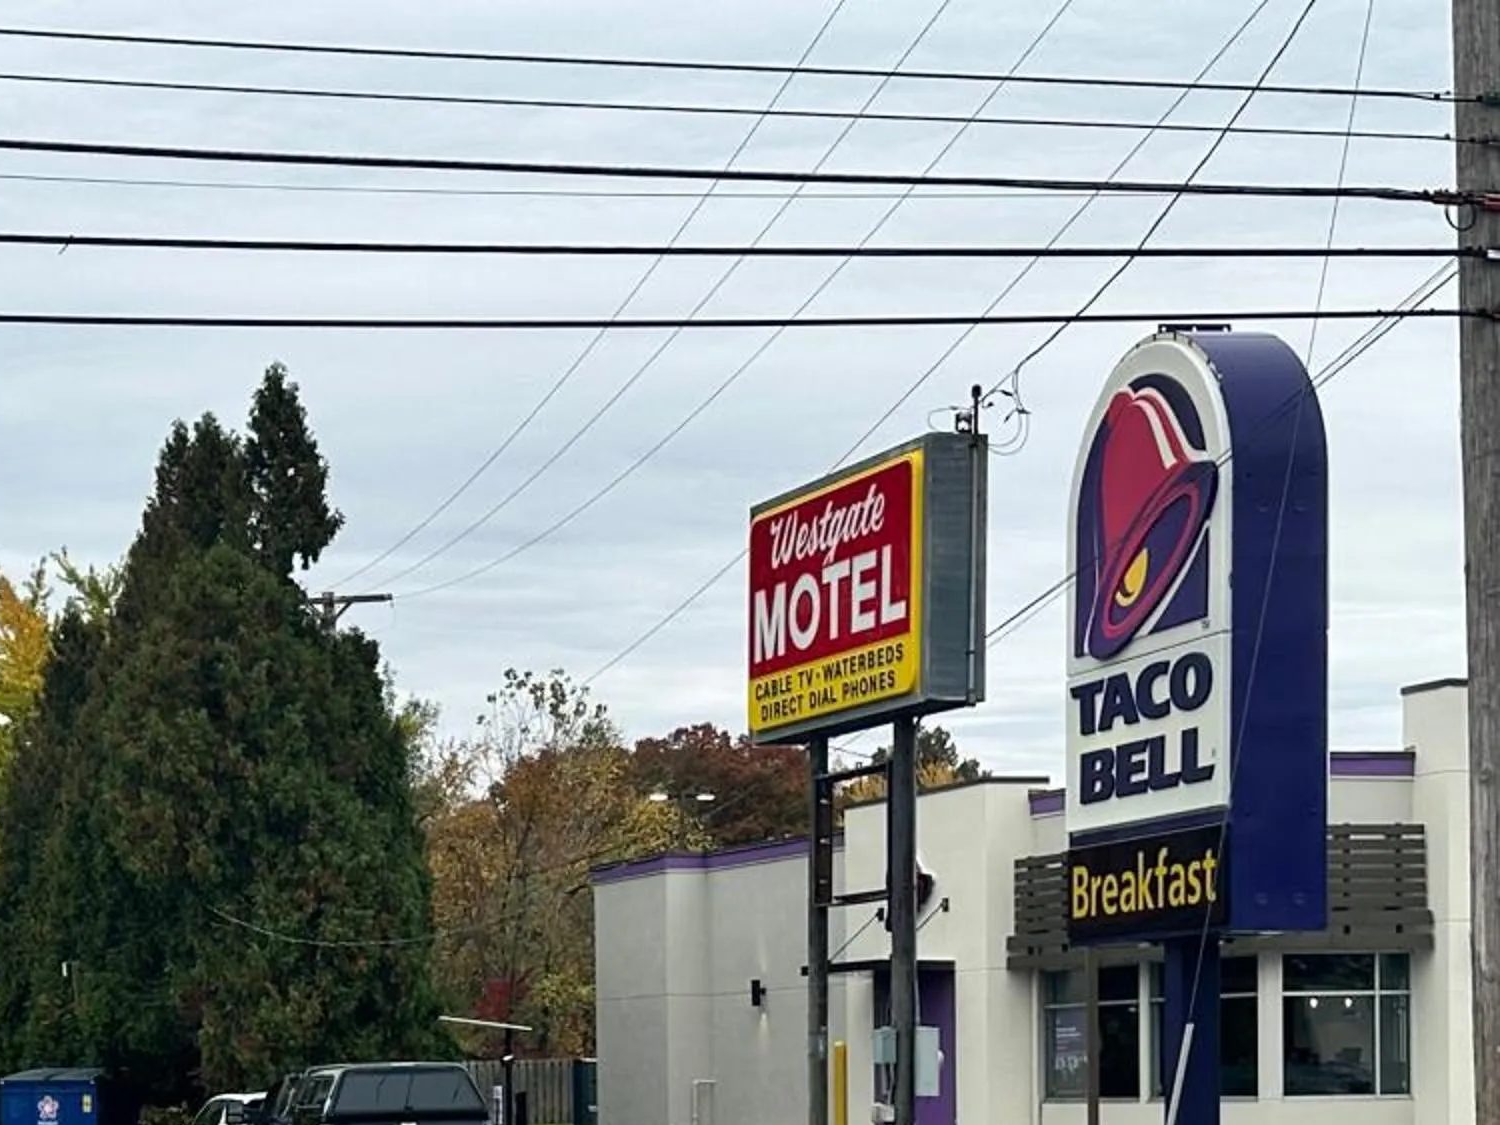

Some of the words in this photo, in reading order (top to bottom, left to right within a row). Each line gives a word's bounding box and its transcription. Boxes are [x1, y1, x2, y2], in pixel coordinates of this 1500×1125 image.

[770, 483, 886, 570] Westgate
[753, 544, 907, 665] MOTEL
[755, 674, 793, 700] CABLE
[798, 668, 815, 689] TV
[821, 643, 904, 682] WATERBEDS
[761, 694, 804, 721] DIRECT
[809, 686, 837, 709] DIAL
[842, 670, 896, 698] PHONES
[1070, 652, 1213, 736] TACO
[1080, 727, 1215, 805] BELL
[1072, 847, 1217, 920] Breakfast
